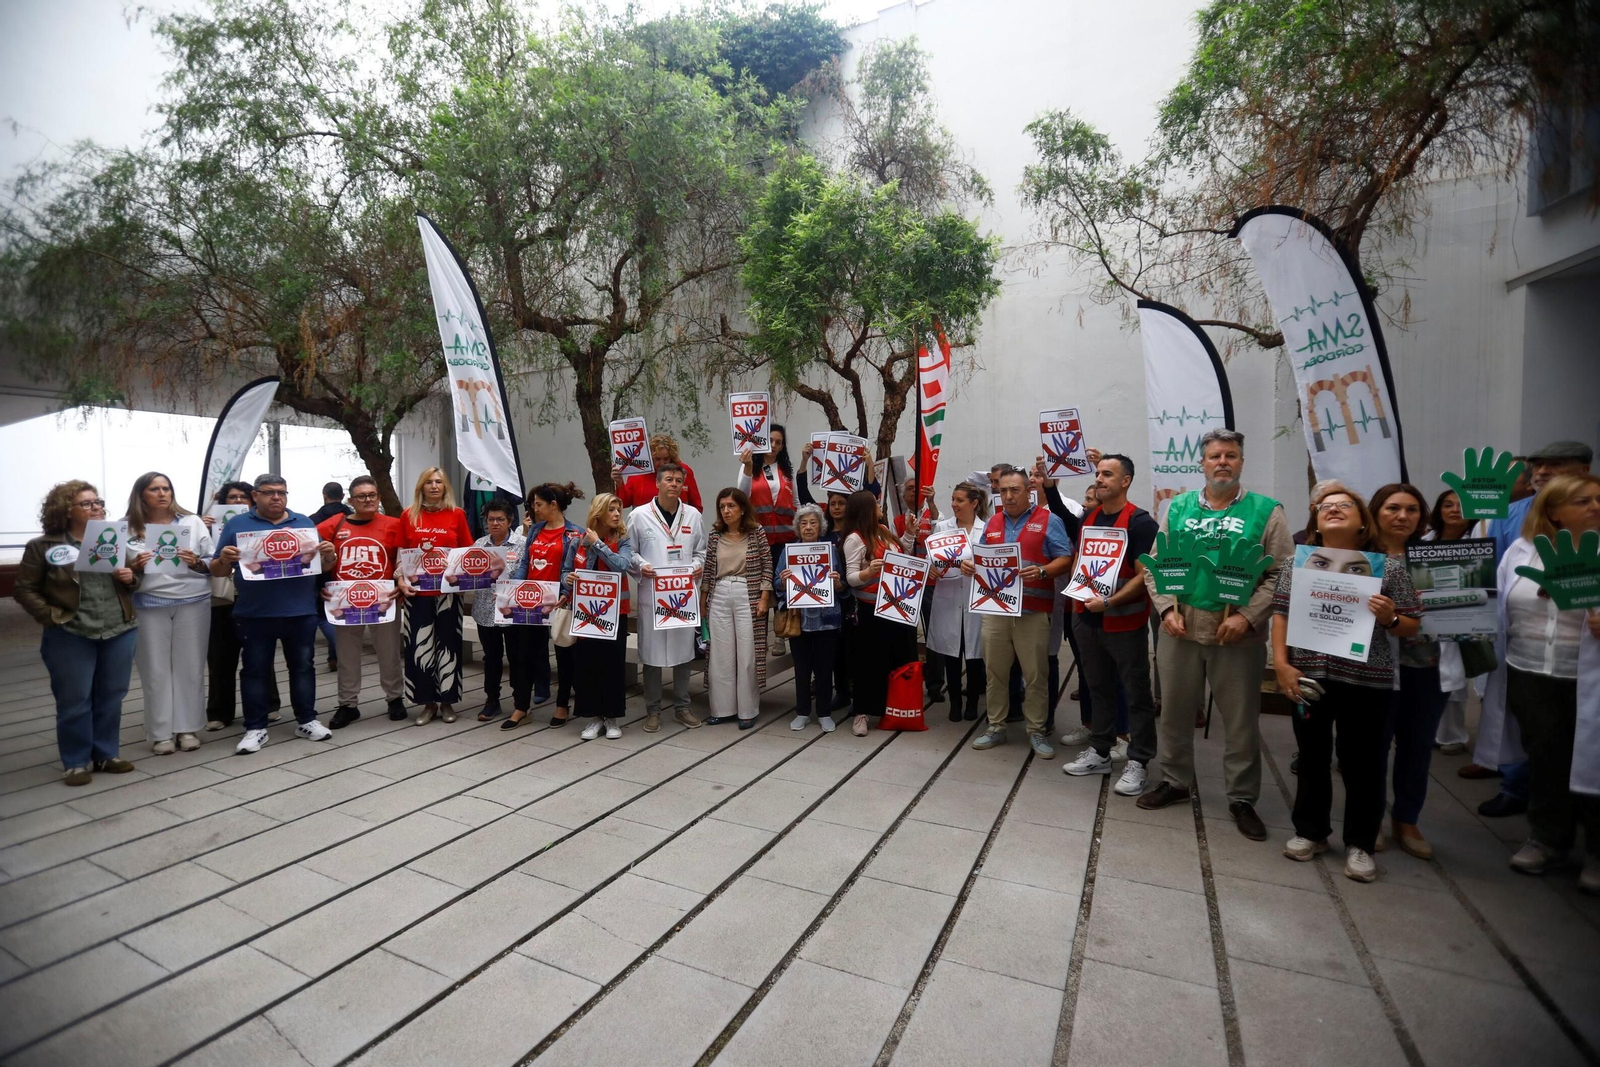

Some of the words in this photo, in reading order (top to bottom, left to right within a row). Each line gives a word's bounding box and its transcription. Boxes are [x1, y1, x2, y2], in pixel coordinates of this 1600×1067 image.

[734, 403, 765, 415] STOP
[745, 418, 762, 433] NO
[1047, 421, 1070, 432] STOP
[614, 430, 640, 443] STOP
[835, 444, 858, 454] STOP
[1052, 431, 1079, 457] NO
[623, 444, 641, 460] NO
[838, 453, 862, 473] NO
[1047, 454, 1086, 467] AGSIONES
[1184, 517, 1245, 533] SATSE
[267, 540, 296, 551] STOP
[931, 536, 962, 548] STOP
[1085, 541, 1118, 555] STOP
[53, 550, 70, 558] CSIF
[341, 545, 380, 566] UGT
[944, 545, 963, 559] NO
[1408, 547, 1494, 558] RECOMENDADO
[464, 557, 487, 566] STOP
[797, 555, 821, 564] STOP
[981, 557, 1008, 567] STOP
[891, 565, 917, 578] STOP
[1090, 560, 1108, 577] NO
[1212, 569, 1253, 579] AGRESIONES
[801, 564, 827, 587] NO
[986, 567, 1016, 591] NO
[580, 582, 613, 596] STOP
[657, 577, 690, 590] STOP
[894, 576, 918, 600] NO
[1572, 579, 1598, 588] CUIDA
[350, 590, 375, 599] STOP
[518, 590, 540, 600] STOP
[668, 593, 688, 608] NO
[1219, 593, 1239, 601] SATSE
[1310, 591, 1360, 604] AGRESIÓN
[1422, 594, 1478, 605] RESPETO
[589, 599, 609, 616] NO
[1321, 603, 1342, 615] NO
